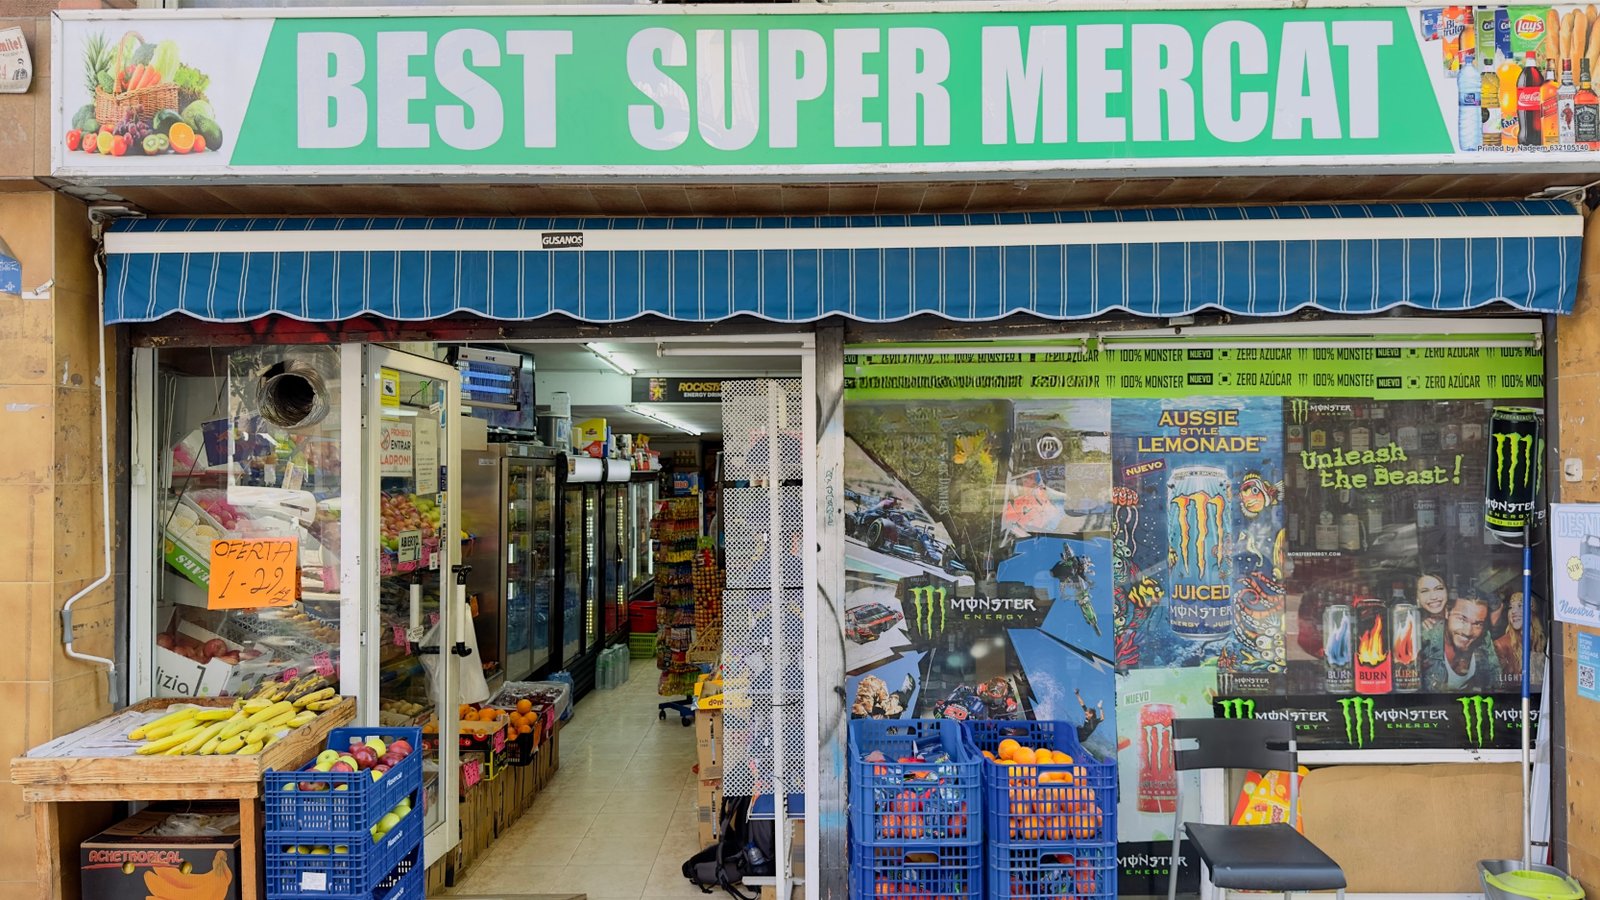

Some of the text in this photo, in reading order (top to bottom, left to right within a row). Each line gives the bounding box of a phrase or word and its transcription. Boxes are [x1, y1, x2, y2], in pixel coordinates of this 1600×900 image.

[297, 20, 1393, 151] BEST SUPER MERCAT
[1506, 145, 1516, 153] by
[1517, 144, 1548, 152] Nadeem
[542, 235, 583, 245] GUSANOS
[1144, 349, 1183, 362] MONSTER
[1189, 350, 1211, 359] NUEVO
[1236, 348, 1256, 361] ZERO
[1313, 348, 1335, 361] 100%
[1120, 374, 1211, 388] 100% MONSTER NUEVO
[1236, 373, 1257, 386] ZERO
[1259, 370, 1292, 386] AZÚCAR
[1313, 374, 1335, 387] 100%
[1378, 377, 1400, 387] NUEVO
[1425, 375, 1446, 389] ZERO
[1501, 375, 1523, 388] 100%
[1310, 404, 1352, 412] MONSTER
[1158, 410, 1239, 427] AUSSIE
[1180, 426, 1219, 436] STYLE
[390, 439, 412, 451] ENTRAR
[1300, 442, 1408, 471] Unleash
[1125, 460, 1164, 477] NUEVO
[1320, 465, 1368, 490] the
[1485, 497, 1536, 513] MONSTER
[214, 541, 294, 563] OFERTA
[1568, 562, 1580, 573] NEW
[1171, 583, 1231, 601] JUICED
[950, 596, 1037, 612] MONSTER
[1170, 604, 1233, 619] MONSTER
[1234, 676, 1270, 685] MONSTER
[1359, 670, 1388, 680] BURN
[1125, 691, 1150, 705] NUEVO
[1255, 709, 1329, 722] MONSTER
[1374, 707, 1449, 722] MONSTER
